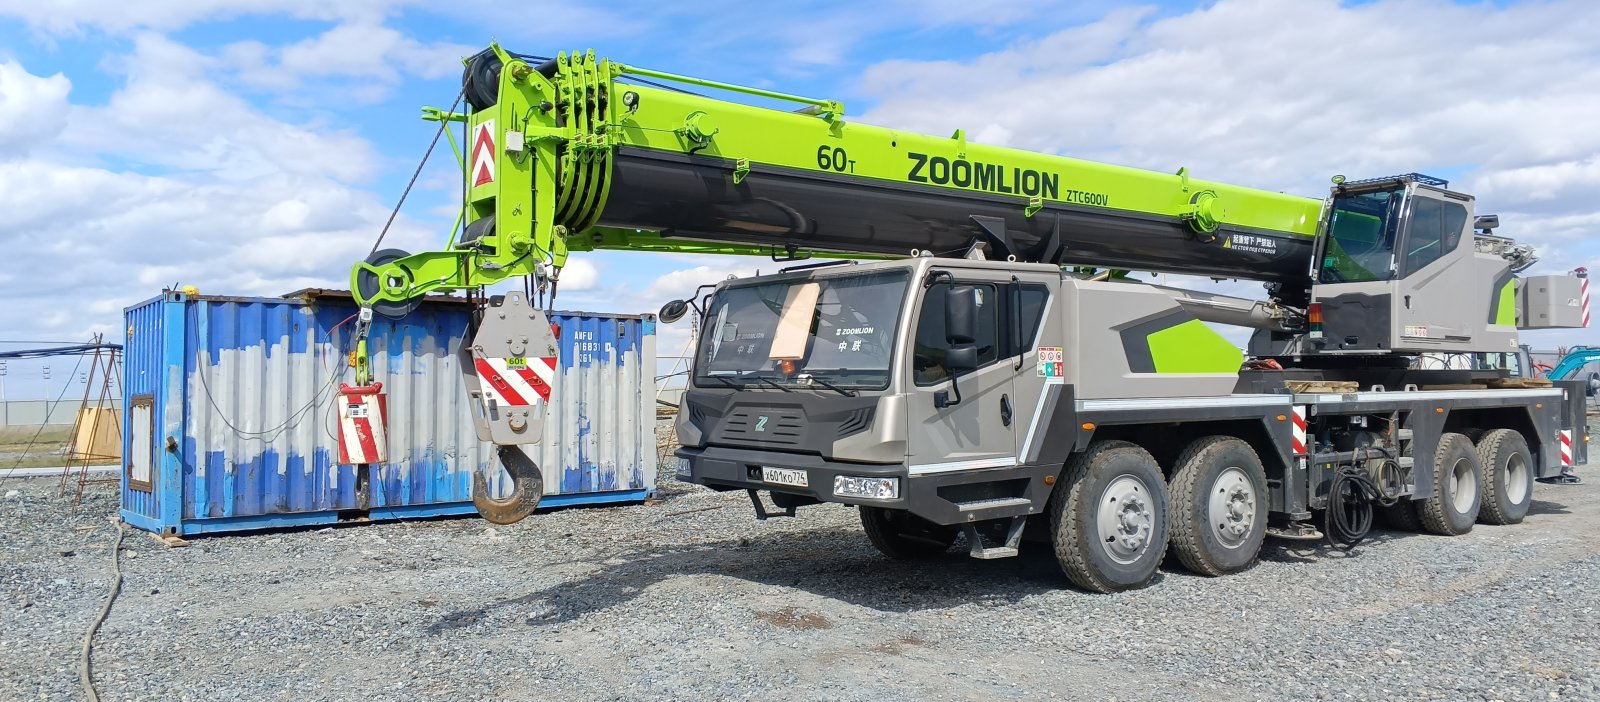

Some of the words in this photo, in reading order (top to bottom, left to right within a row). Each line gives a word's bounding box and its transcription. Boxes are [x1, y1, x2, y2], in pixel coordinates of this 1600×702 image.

[907, 152, 1059, 199] ZOOMLION
[1066, 189, 1109, 206] ZTC600V
[842, 327, 874, 335] ZOOMLION
[508, 357, 524, 365] 60t
